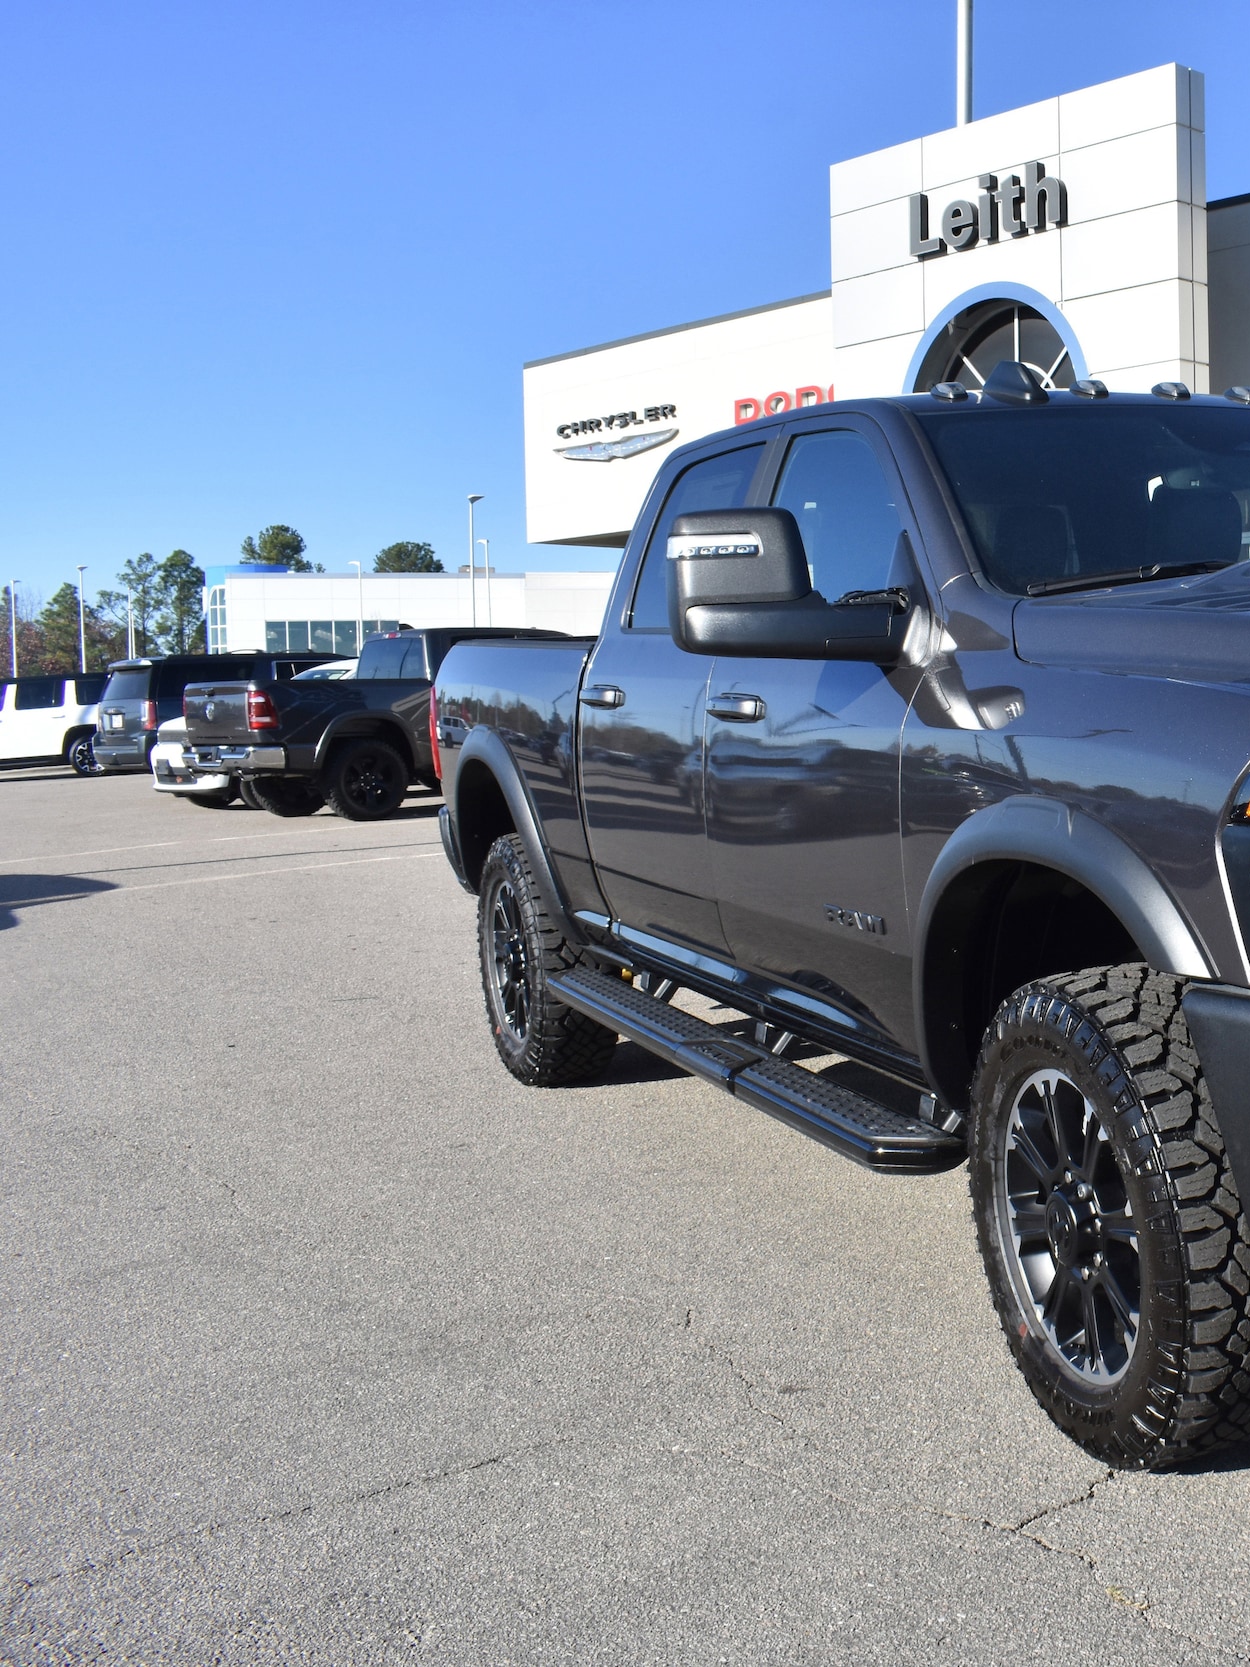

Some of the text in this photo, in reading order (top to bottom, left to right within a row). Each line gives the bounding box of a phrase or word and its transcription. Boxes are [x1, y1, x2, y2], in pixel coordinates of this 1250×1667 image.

[909, 161, 1068, 262] Leith
[556, 404, 678, 439] CHRYSLER
[734, 384, 834, 427] DOD
[823, 904, 887, 936] RAM
